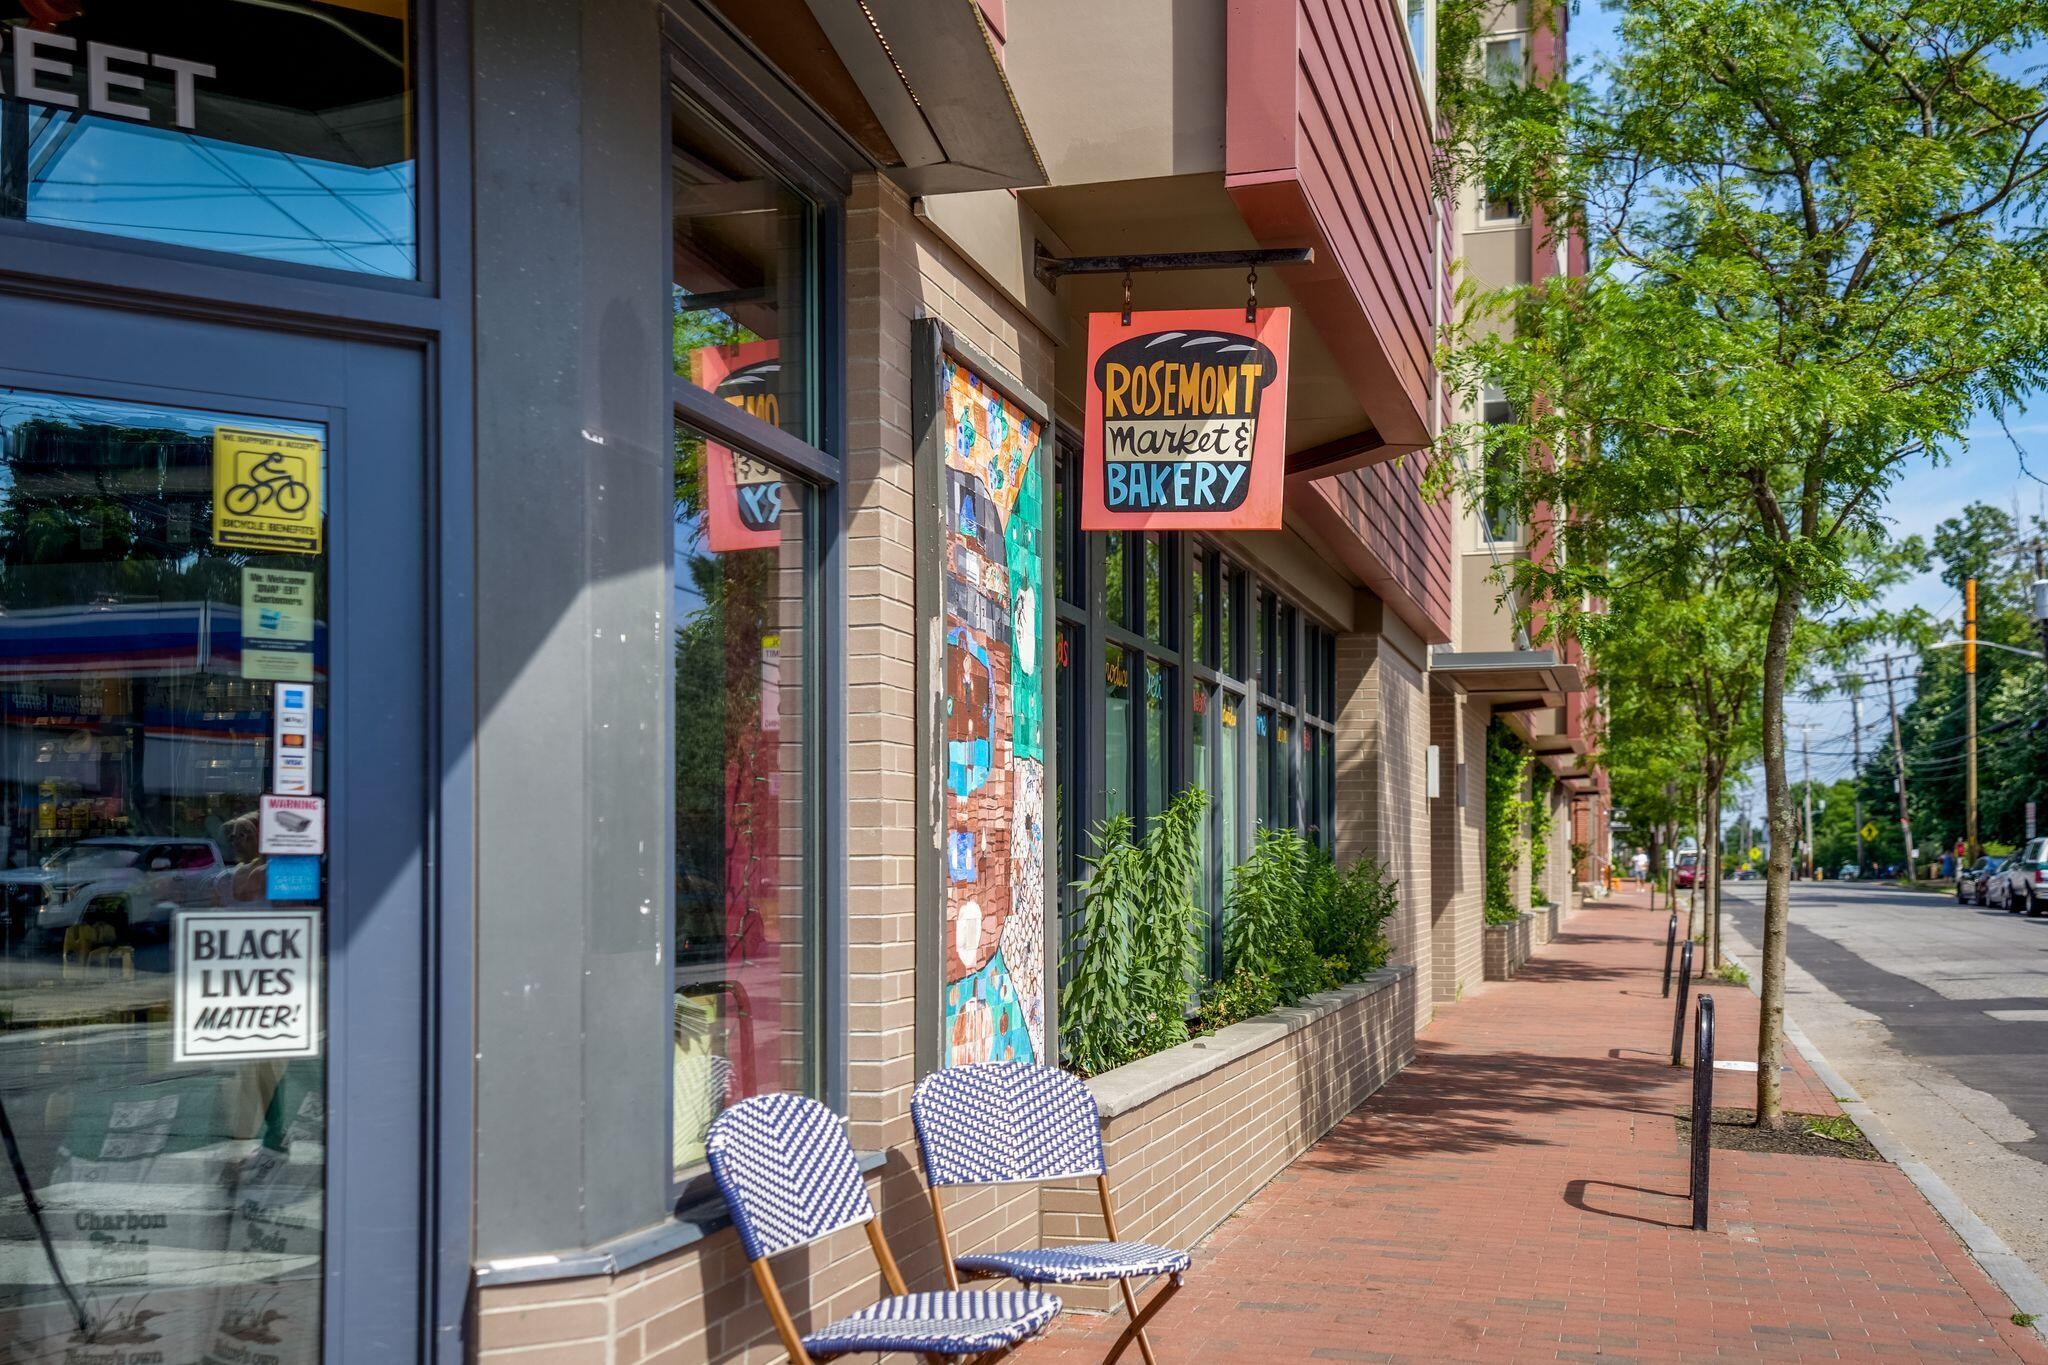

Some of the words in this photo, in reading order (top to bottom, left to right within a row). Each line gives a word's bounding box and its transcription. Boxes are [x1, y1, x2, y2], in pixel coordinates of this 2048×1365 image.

[0, 26, 216, 129] EET
[1105, 360, 1262, 418] ROSEMONT
[238, 436, 274, 446] SUPPORT
[1234, 421, 1250, 458] &
[1107, 462, 1247, 507] BAKERY
[223, 518, 266, 531] BICYCLE
[268, 523, 317, 536] BENEFITS
[267, 574, 307, 586] Welcome
[253, 594, 304, 606] Customers
[269, 798, 319, 811] WARNING
[193, 928, 302, 961] BLACK
[201, 967, 296, 998] LIVES
[193, 1003, 301, 1031] MATTER!
[75, 1209, 168, 1232] Charbon
